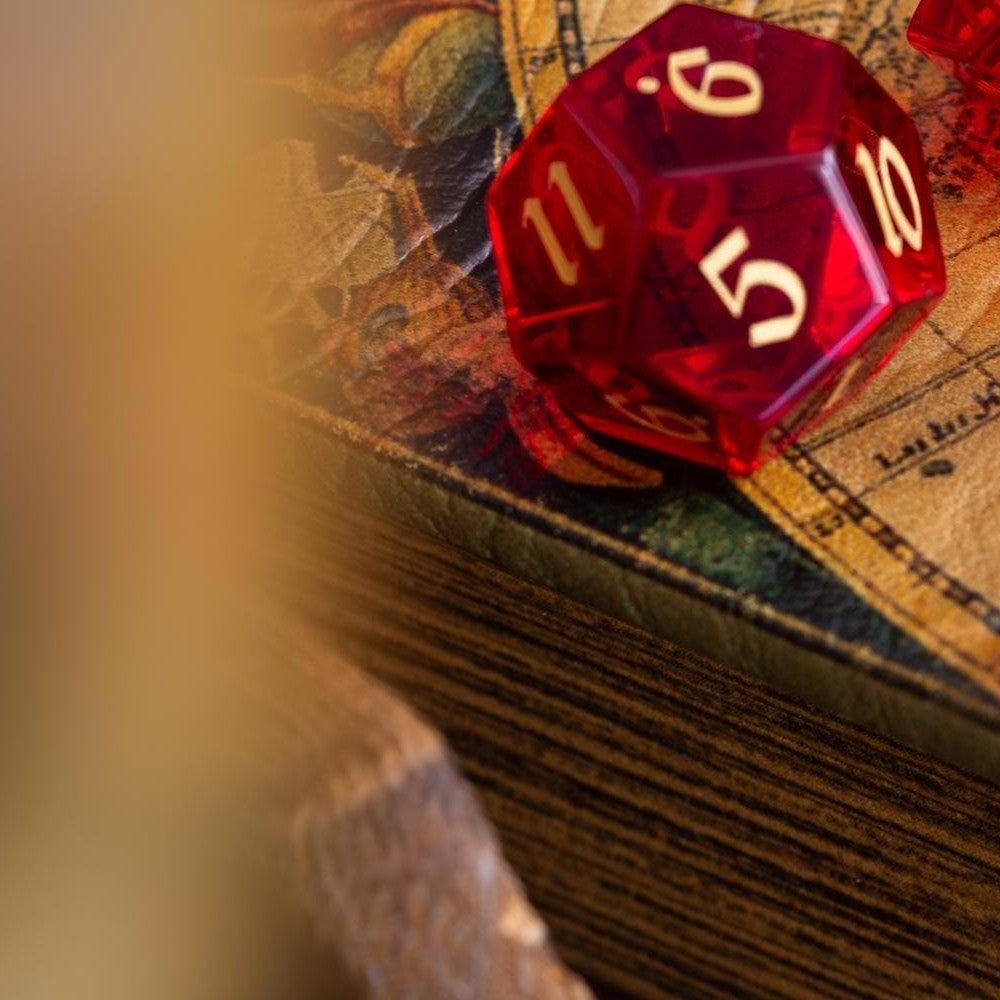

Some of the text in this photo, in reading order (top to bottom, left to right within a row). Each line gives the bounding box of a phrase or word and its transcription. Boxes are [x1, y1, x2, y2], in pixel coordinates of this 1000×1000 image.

[522, 161, 604, 286] 11
[855, 137, 923, 258] 10
[699, 226, 807, 348] 5
